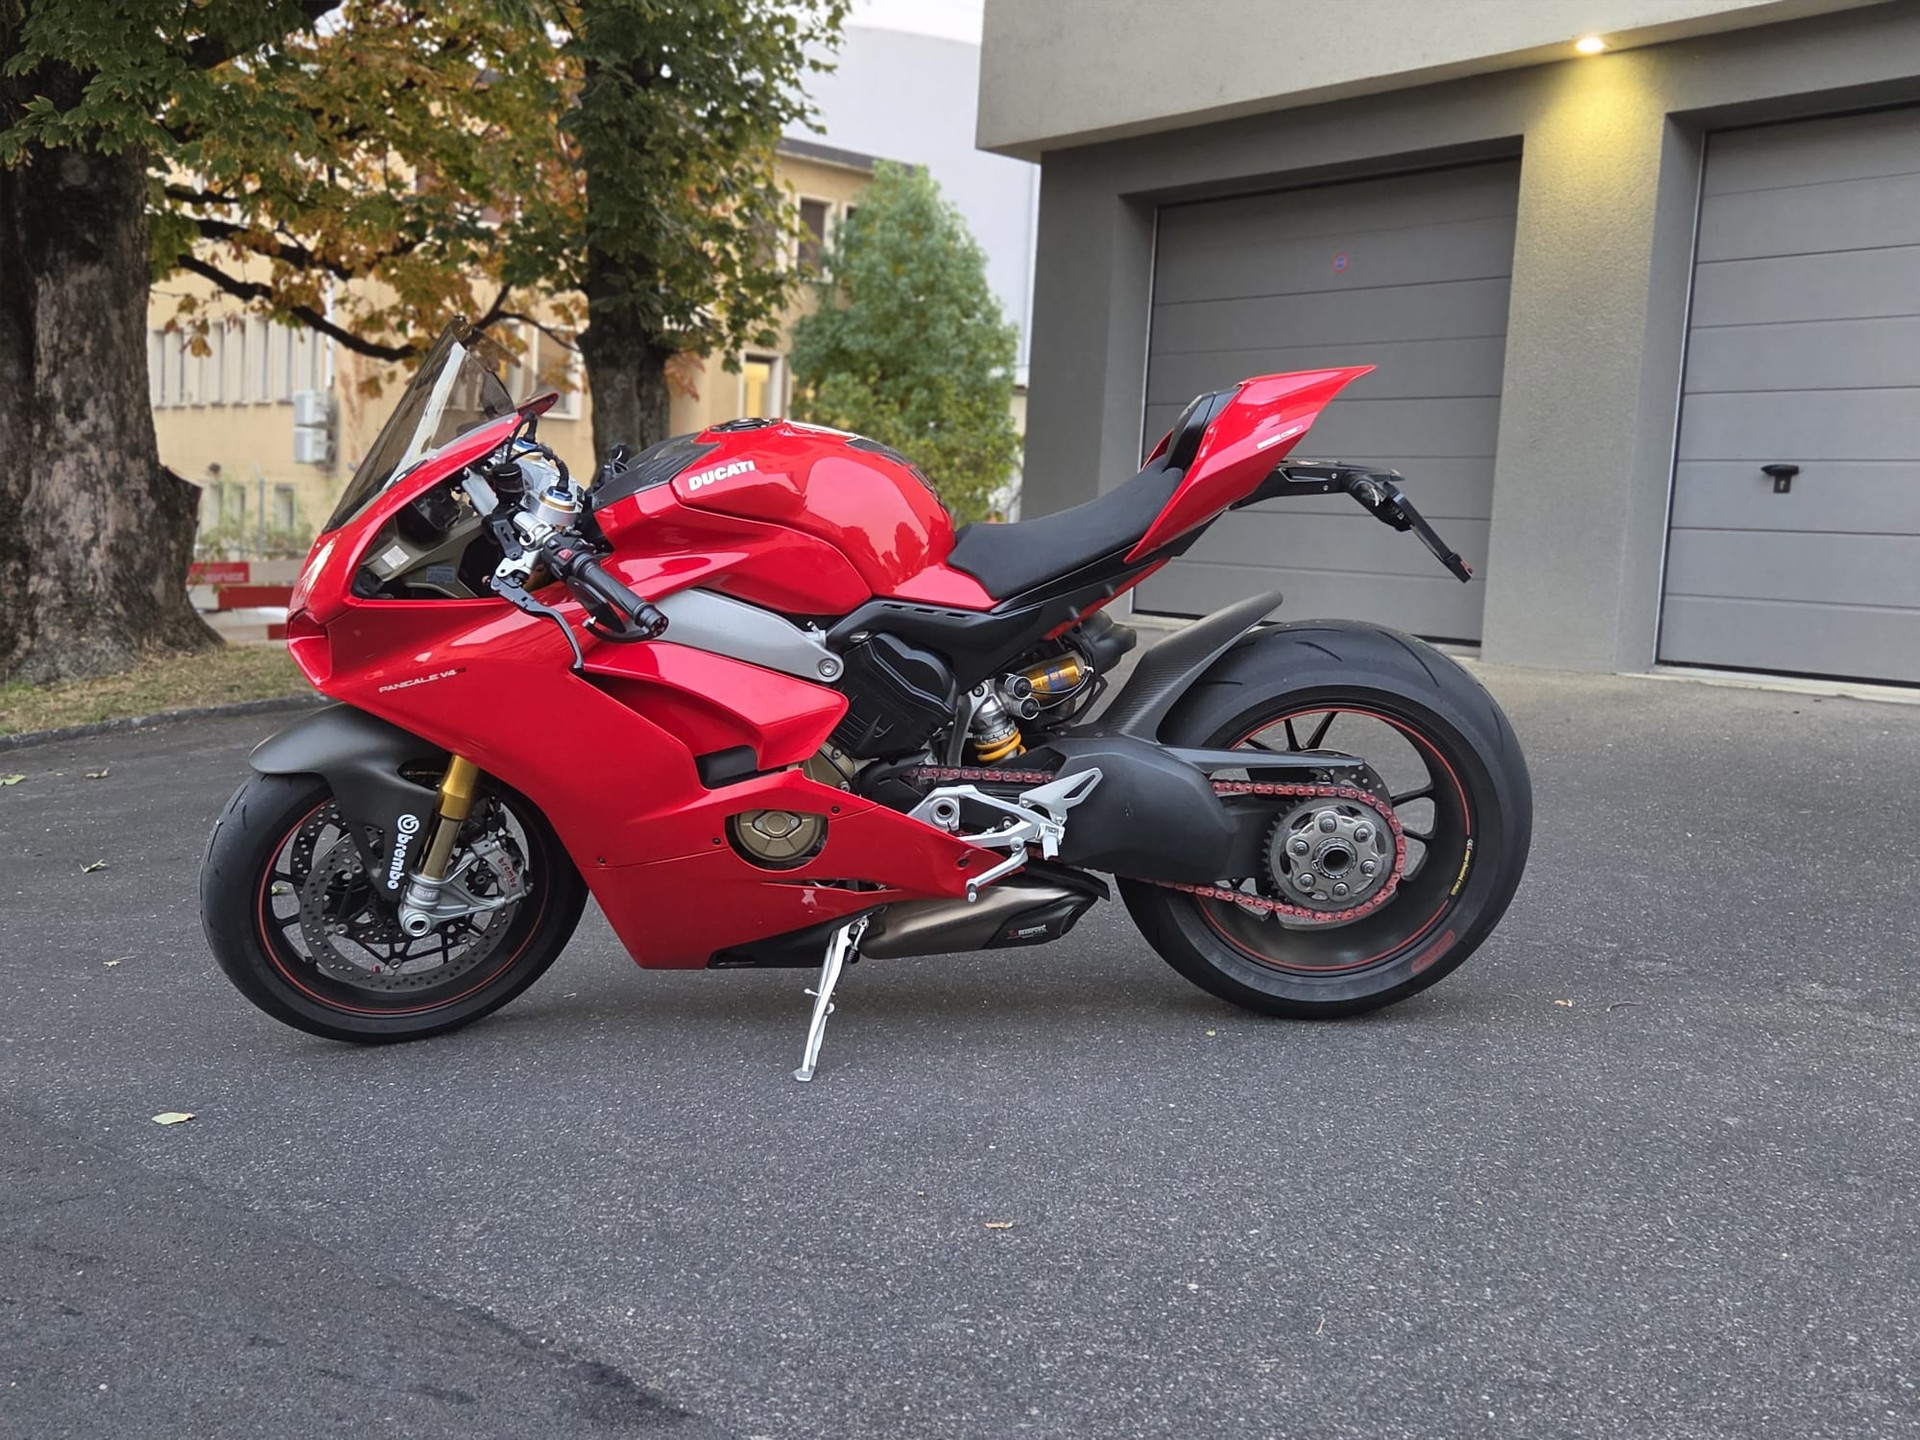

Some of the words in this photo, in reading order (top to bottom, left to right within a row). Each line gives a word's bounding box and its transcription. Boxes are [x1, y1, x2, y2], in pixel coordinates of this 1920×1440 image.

[688, 460, 756, 491] DUCATI
[440, 669, 457, 678] V4
[387, 833, 413, 890] brembo
